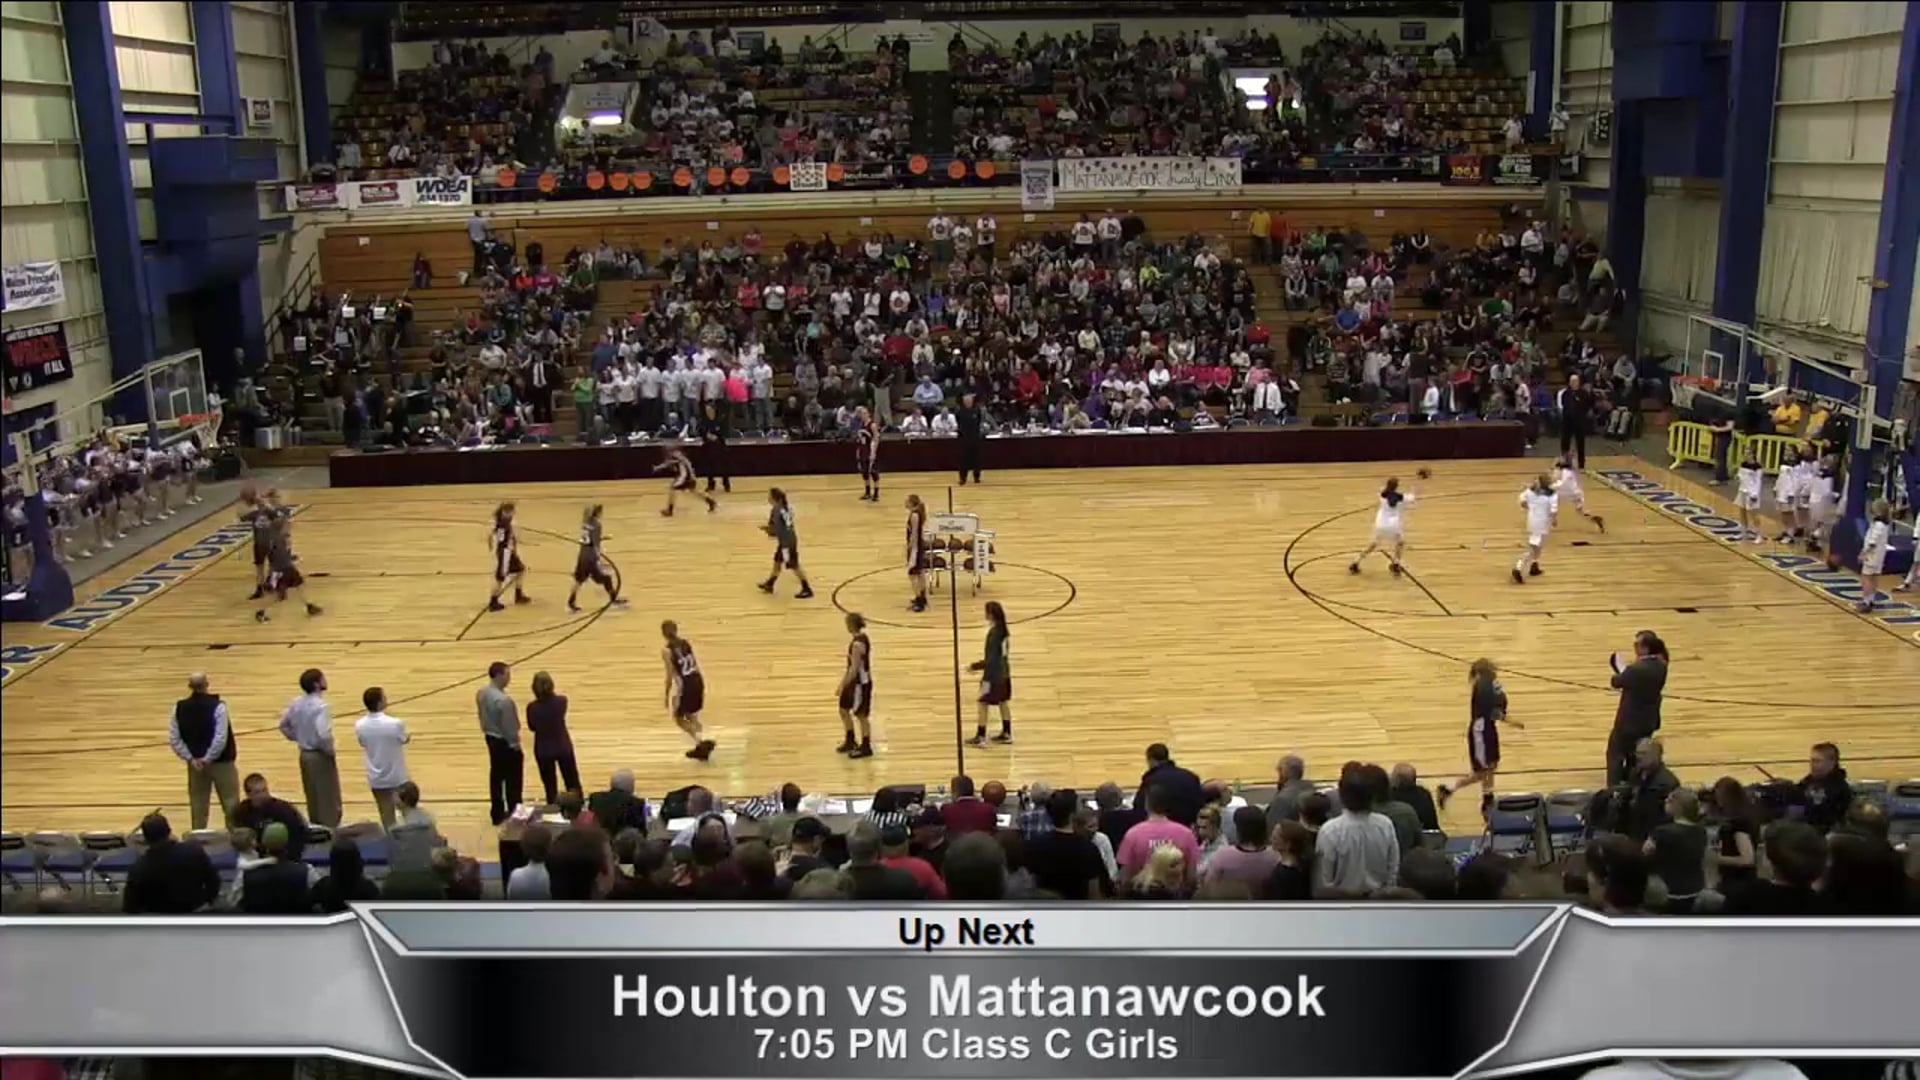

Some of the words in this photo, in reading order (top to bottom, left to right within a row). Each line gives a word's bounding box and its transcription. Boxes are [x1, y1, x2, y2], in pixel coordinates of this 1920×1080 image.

[416, 179, 467, 194] WDEA
[418, 194, 435, 203] AM
[438, 193, 461, 203] 1370
